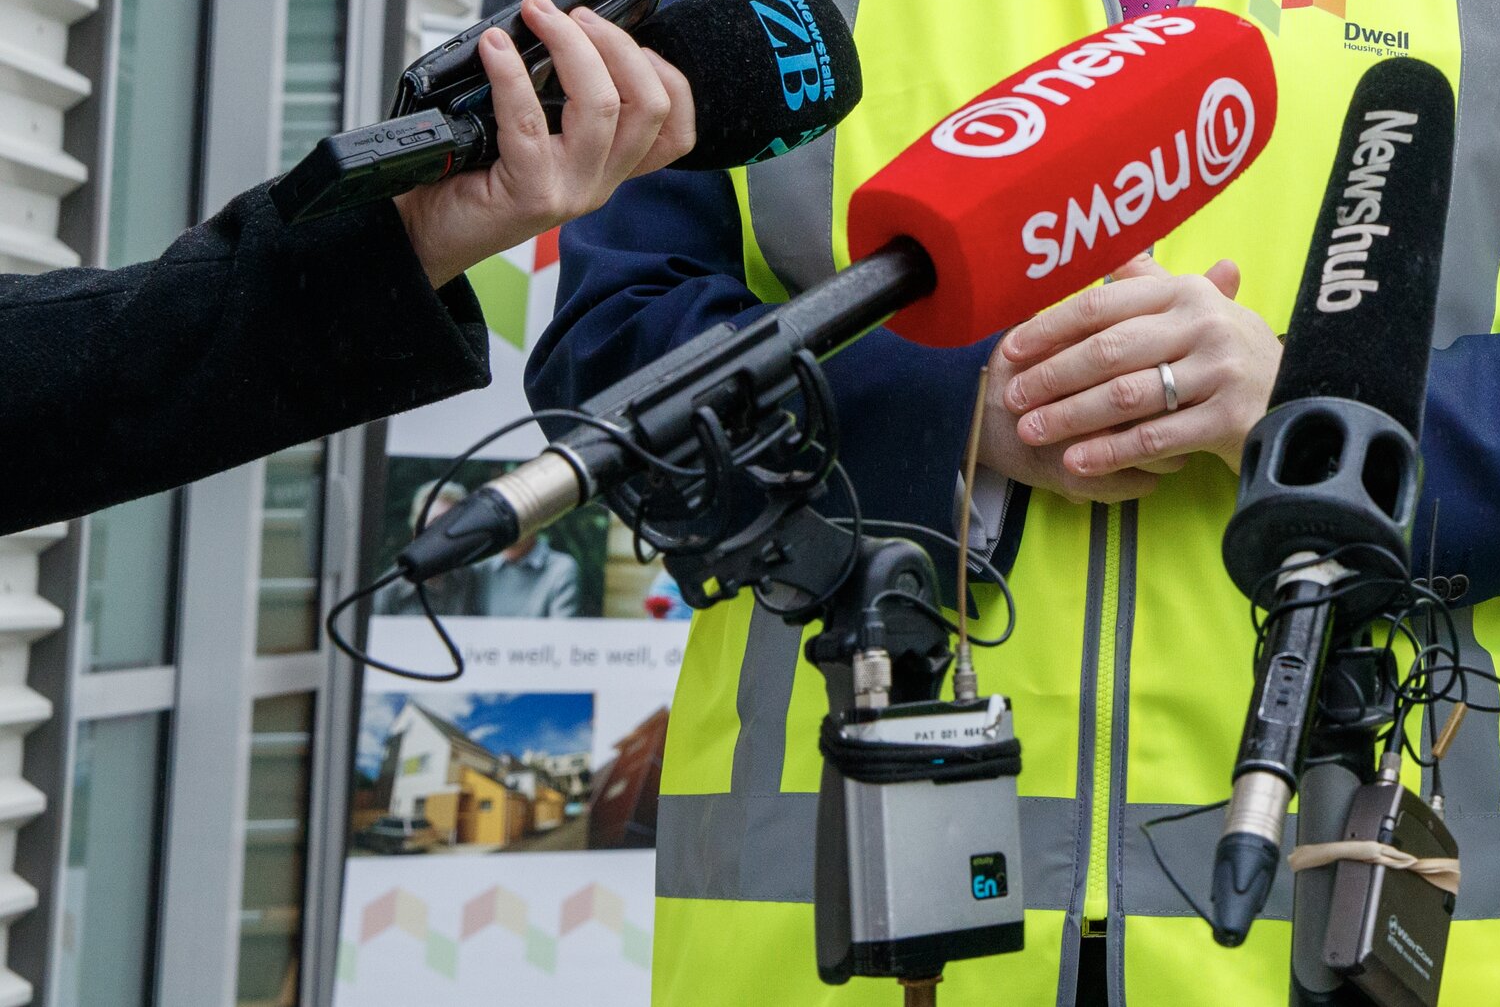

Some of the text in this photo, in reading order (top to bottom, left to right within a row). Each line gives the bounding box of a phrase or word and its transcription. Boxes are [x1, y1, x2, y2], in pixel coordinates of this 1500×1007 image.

[1344, 22, 1409, 49] Dwell
[1344, 42, 1409, 58] Housing Trust
[1316, 110, 1419, 313] Newshub
[463, 646, 498, 665] ive
[508, 645, 561, 669] well,
[570, 646, 599, 665] be
[606, 645, 657, 669] well,
